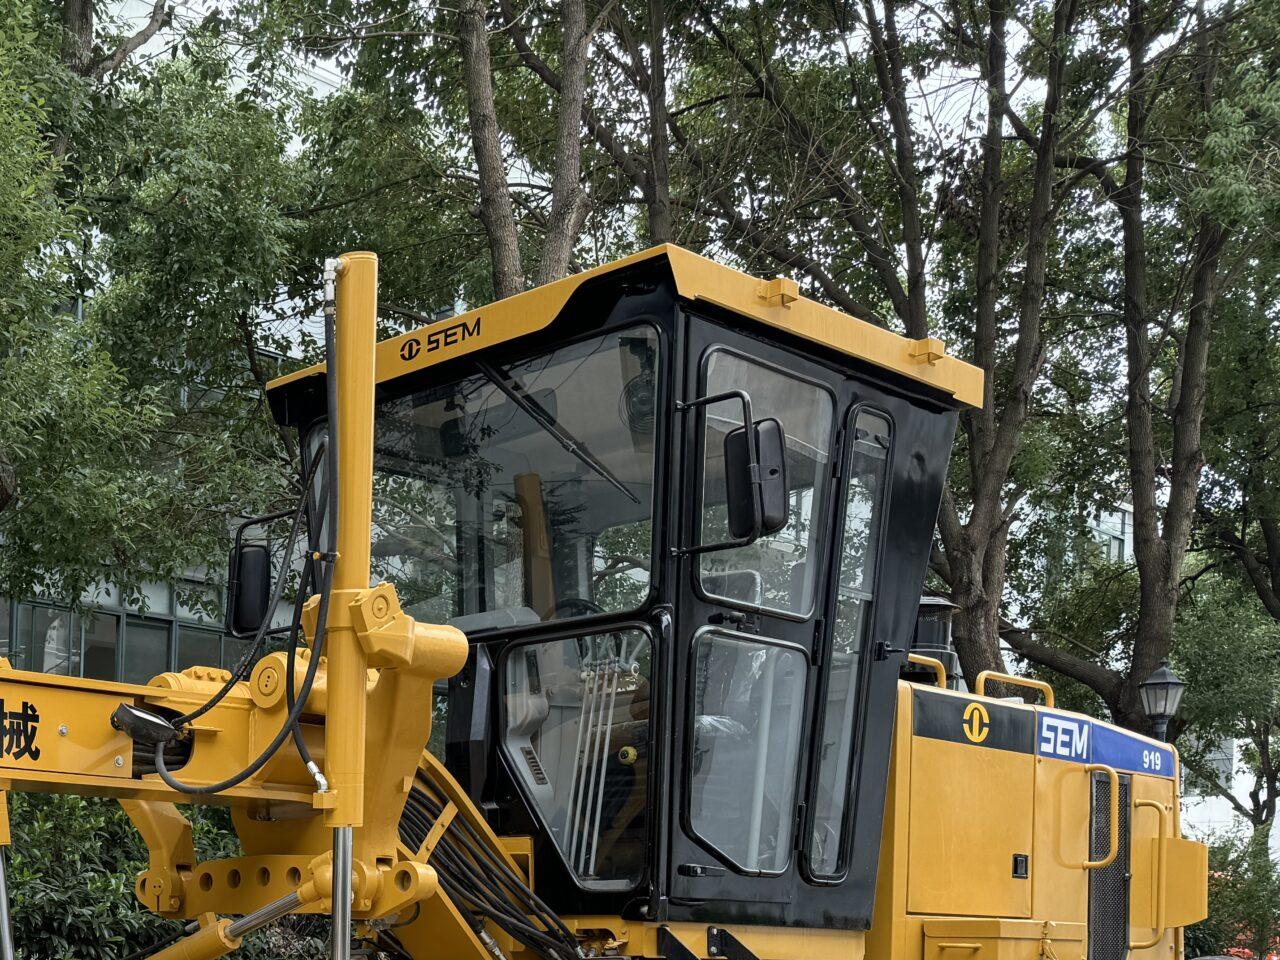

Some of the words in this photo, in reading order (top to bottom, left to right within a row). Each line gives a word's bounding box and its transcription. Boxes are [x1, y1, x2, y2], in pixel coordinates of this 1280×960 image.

[426, 316, 481, 353] SEM
[1040, 716, 1088, 760] SEM
[1142, 749, 1162, 771] 919
